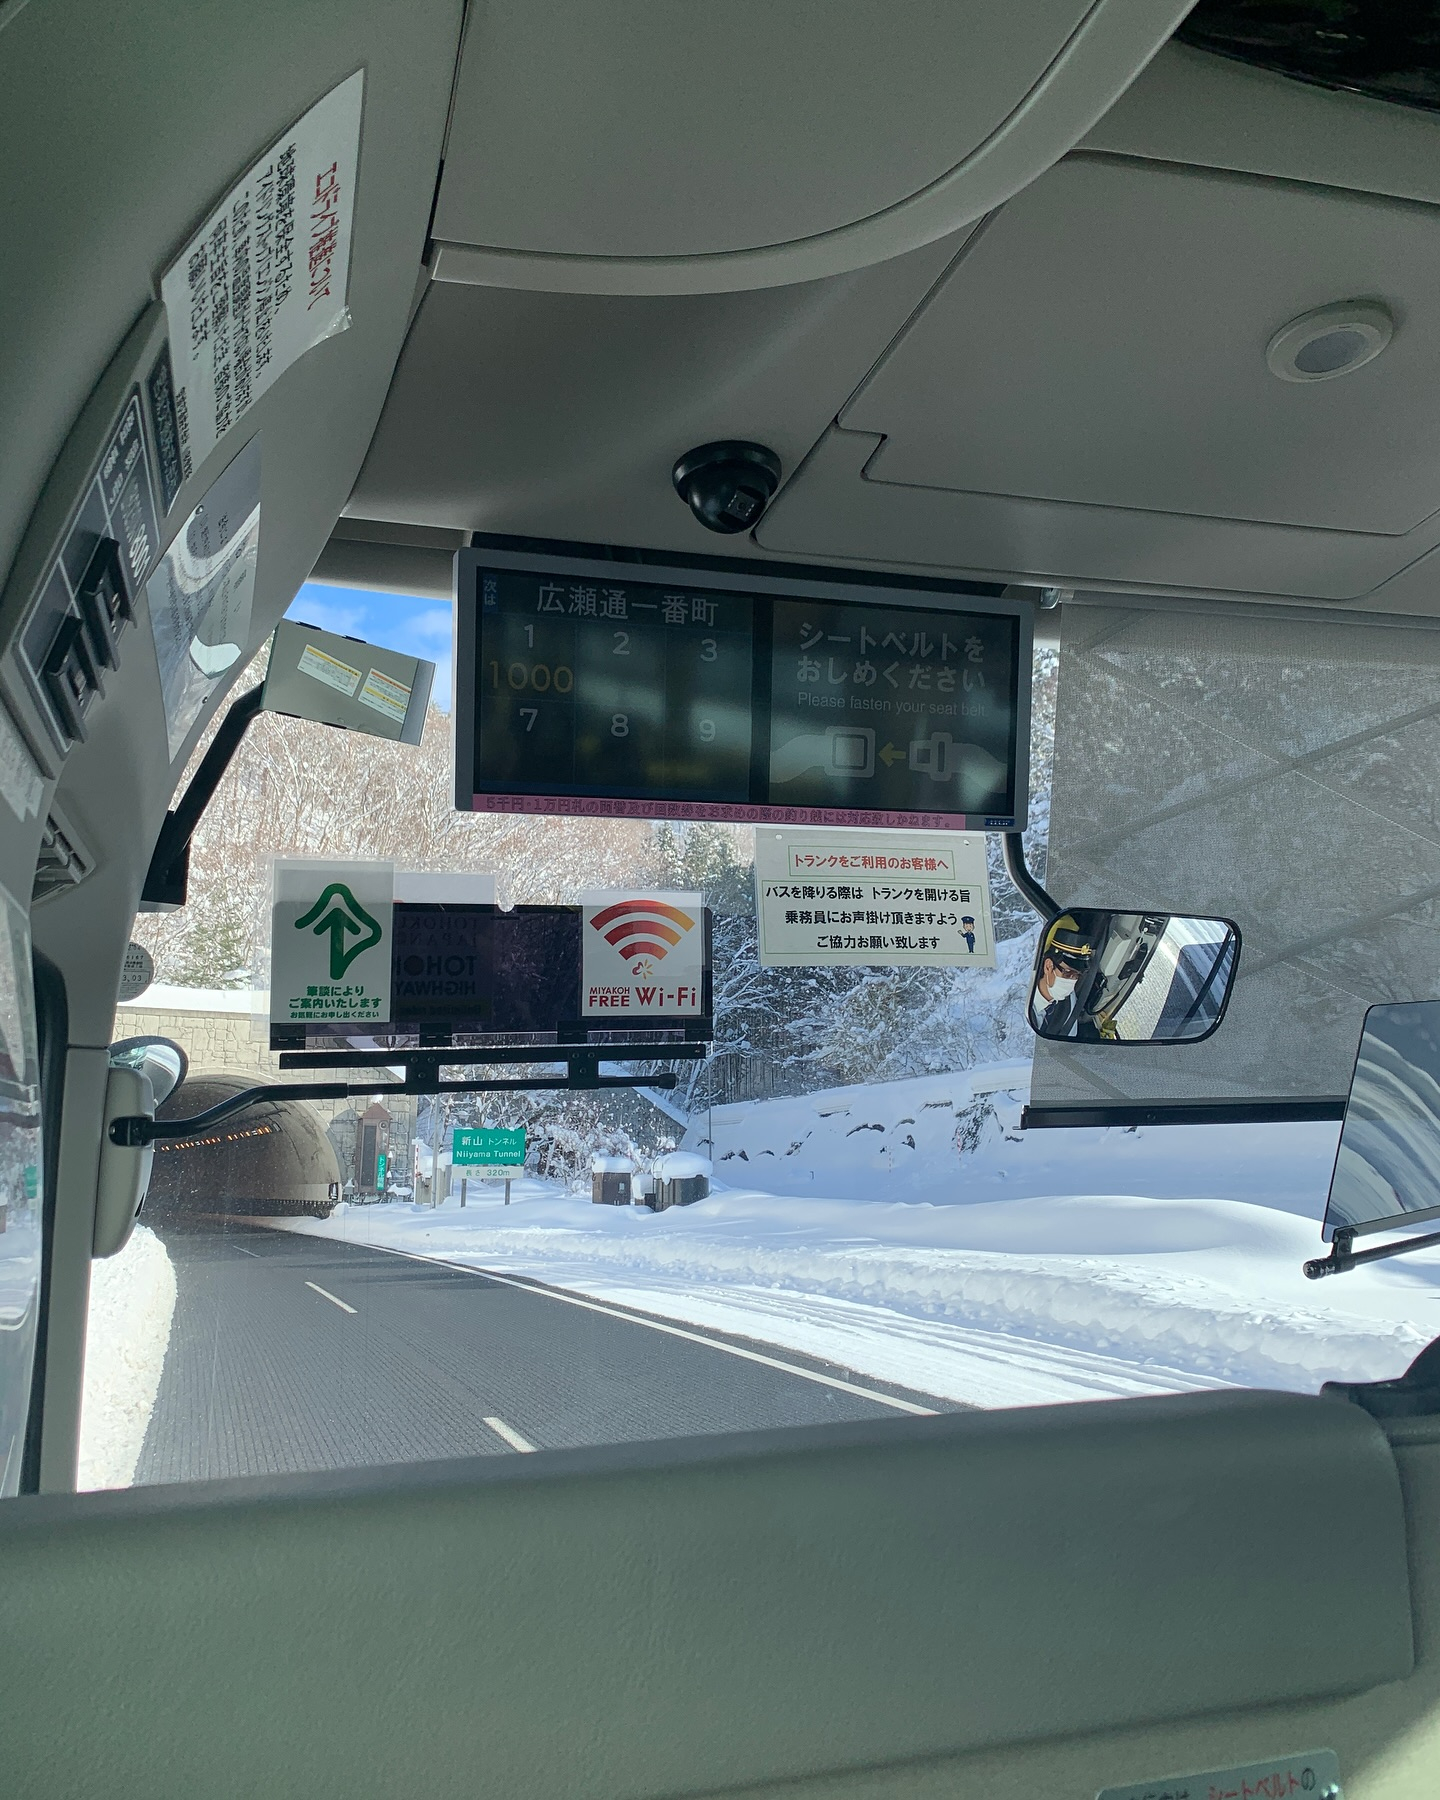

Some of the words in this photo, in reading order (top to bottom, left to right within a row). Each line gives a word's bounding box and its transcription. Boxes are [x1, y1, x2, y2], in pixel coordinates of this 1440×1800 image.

[307, 161, 341, 311] エコドライブ推進について
[483, 579, 497, 606] 次は
[537, 582, 719, 627] 広瀬通一番町
[524, 624, 534, 649] 1
[613, 632, 630, 656] 2
[799, 622, 985, 663] シートベルトを
[700, 639, 718, 662] 3
[489, 660, 574, 693] 1000
[797, 655, 986, 693] おしめください
[798, 692, 845, 708] Please
[850, 696, 891, 711] fasten
[895, 700, 924, 714] your
[929, 703, 957, 715] seat
[519, 708, 538, 732] 7
[610, 713, 629, 737] 8
[699, 719, 716, 742] 9
[795, 854, 949, 871] トランクをご利用のお客様へ
[766, 886, 864, 900] バスを降りる際は
[872, 887, 971, 903] トランクを開ける旨
[785, 910, 957, 926] 乗務員にお声掛け頂きますよう
[817, 935, 940, 950] ご協力お願い致します
[306, 985, 364, 997] 筆談により
[589, 986, 630, 994] MIYAKOH
[635, 987, 696, 1006] Wi-Fi
[589, 995, 630, 1007] FREE
[289, 998, 383, 1009] ご案内いたします
[462, 1136, 483, 1146] 新山
[488, 1137, 517, 1146] トンネル
[456, 1151, 490, 1159] Niiyama
[487, 1169, 510, 1177] 320m
